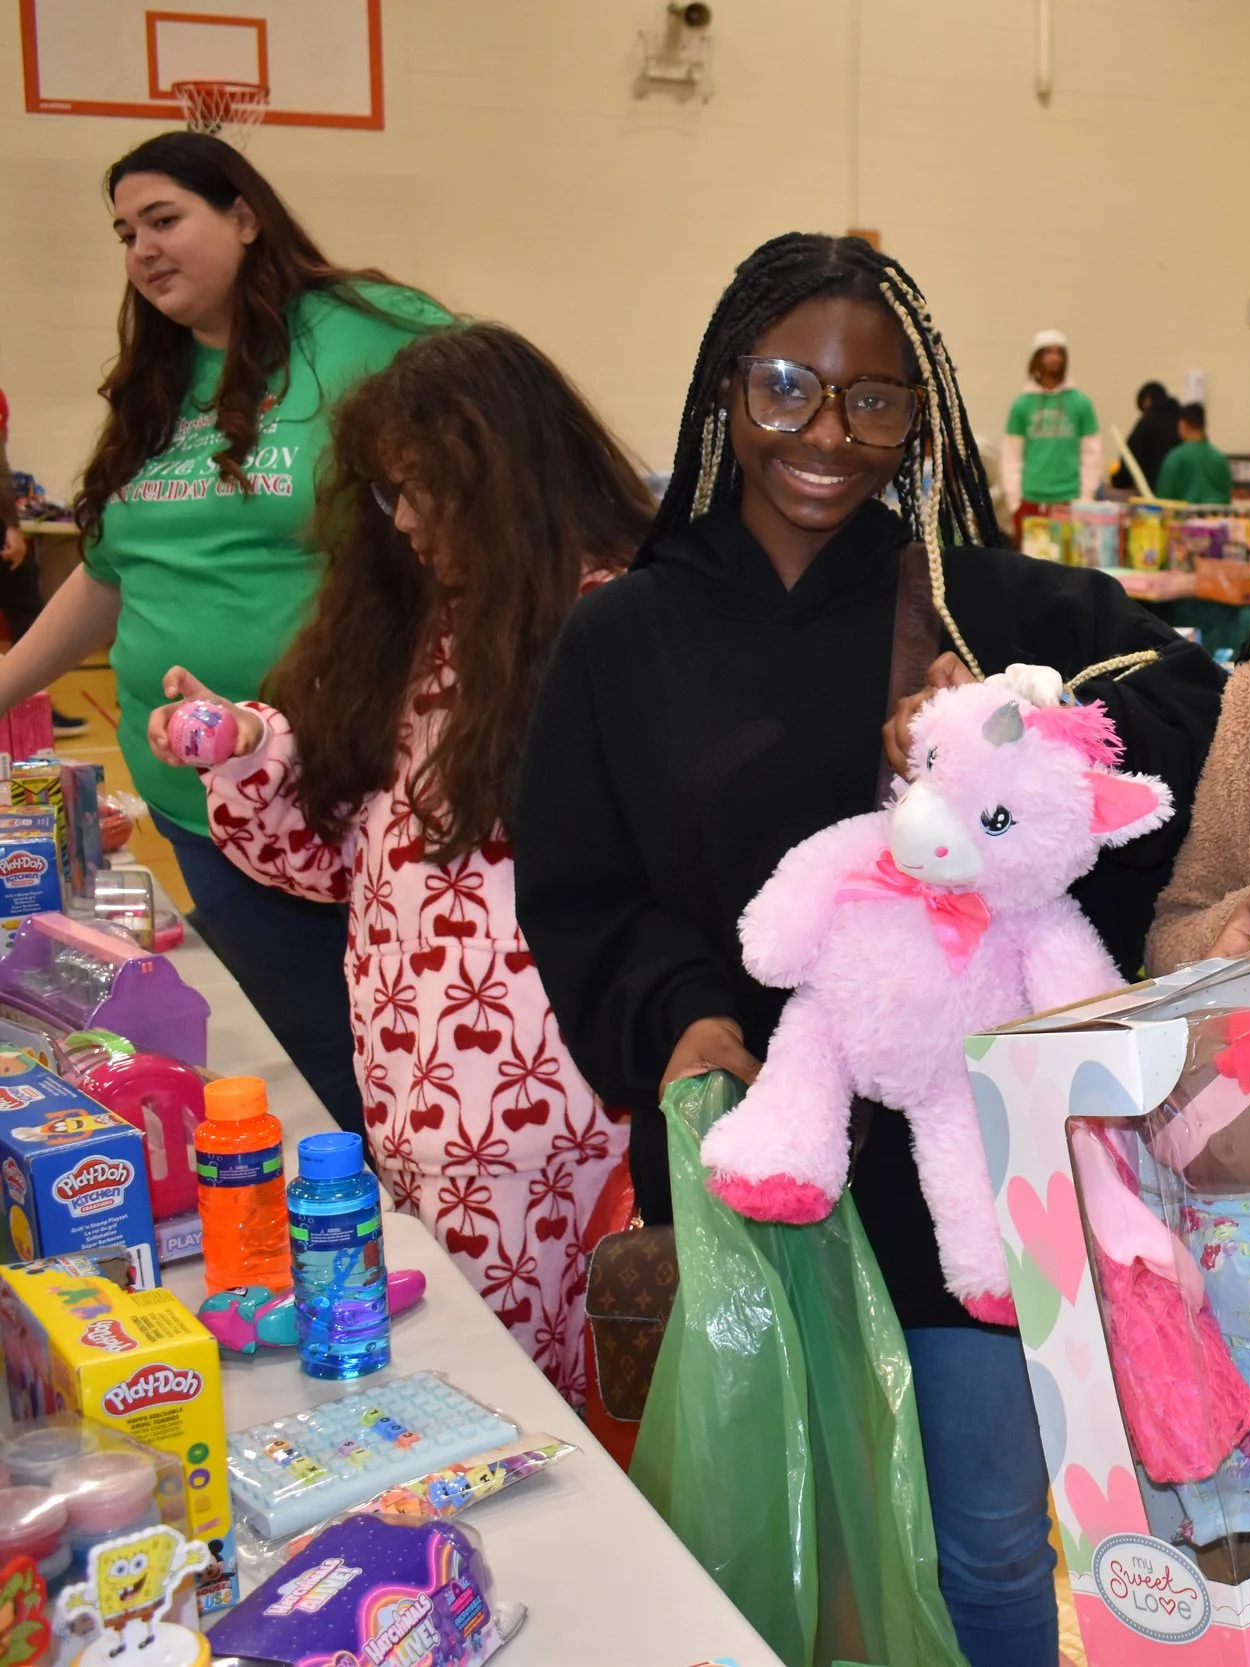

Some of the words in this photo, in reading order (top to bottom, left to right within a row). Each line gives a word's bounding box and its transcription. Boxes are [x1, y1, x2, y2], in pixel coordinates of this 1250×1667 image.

[58, 1162, 127, 1196] Play-Doh
[105, 1369, 199, 1410] Play-Doh
[1110, 1560, 1197, 1600] Sweet
[1131, 1556, 1154, 1574] my
